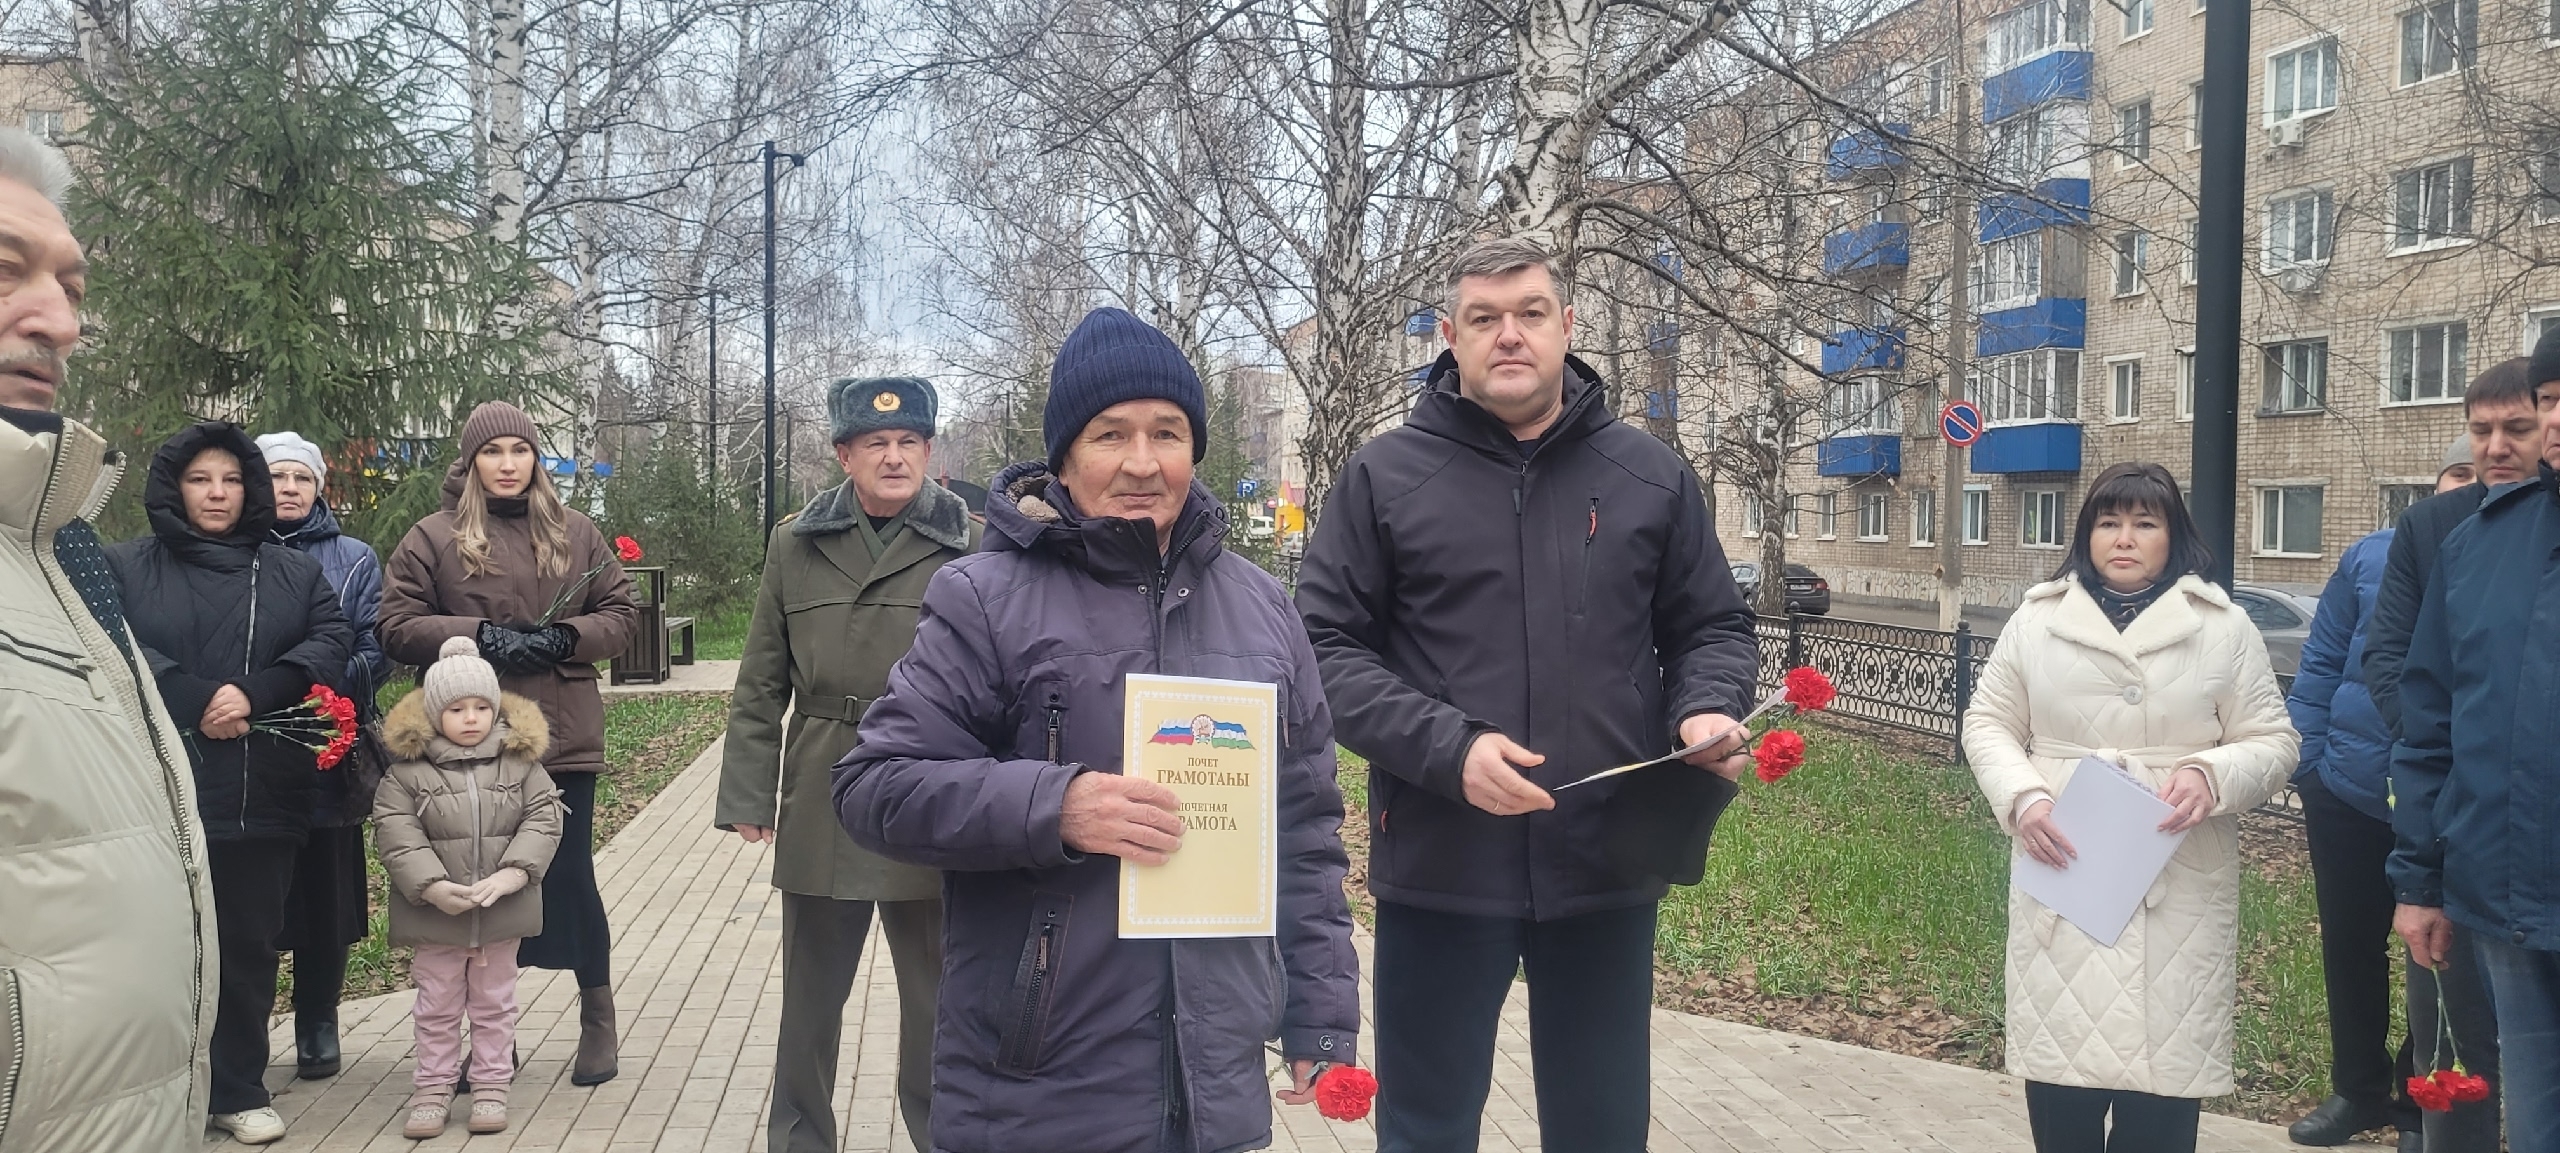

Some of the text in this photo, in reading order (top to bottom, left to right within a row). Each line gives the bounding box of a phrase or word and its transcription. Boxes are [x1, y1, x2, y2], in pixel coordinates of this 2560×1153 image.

[1242, 483, 1253, 498] P
[1187, 757, 1219, 768] ПОЧЕТ
[1177, 815, 1238, 831] РАМОТА
